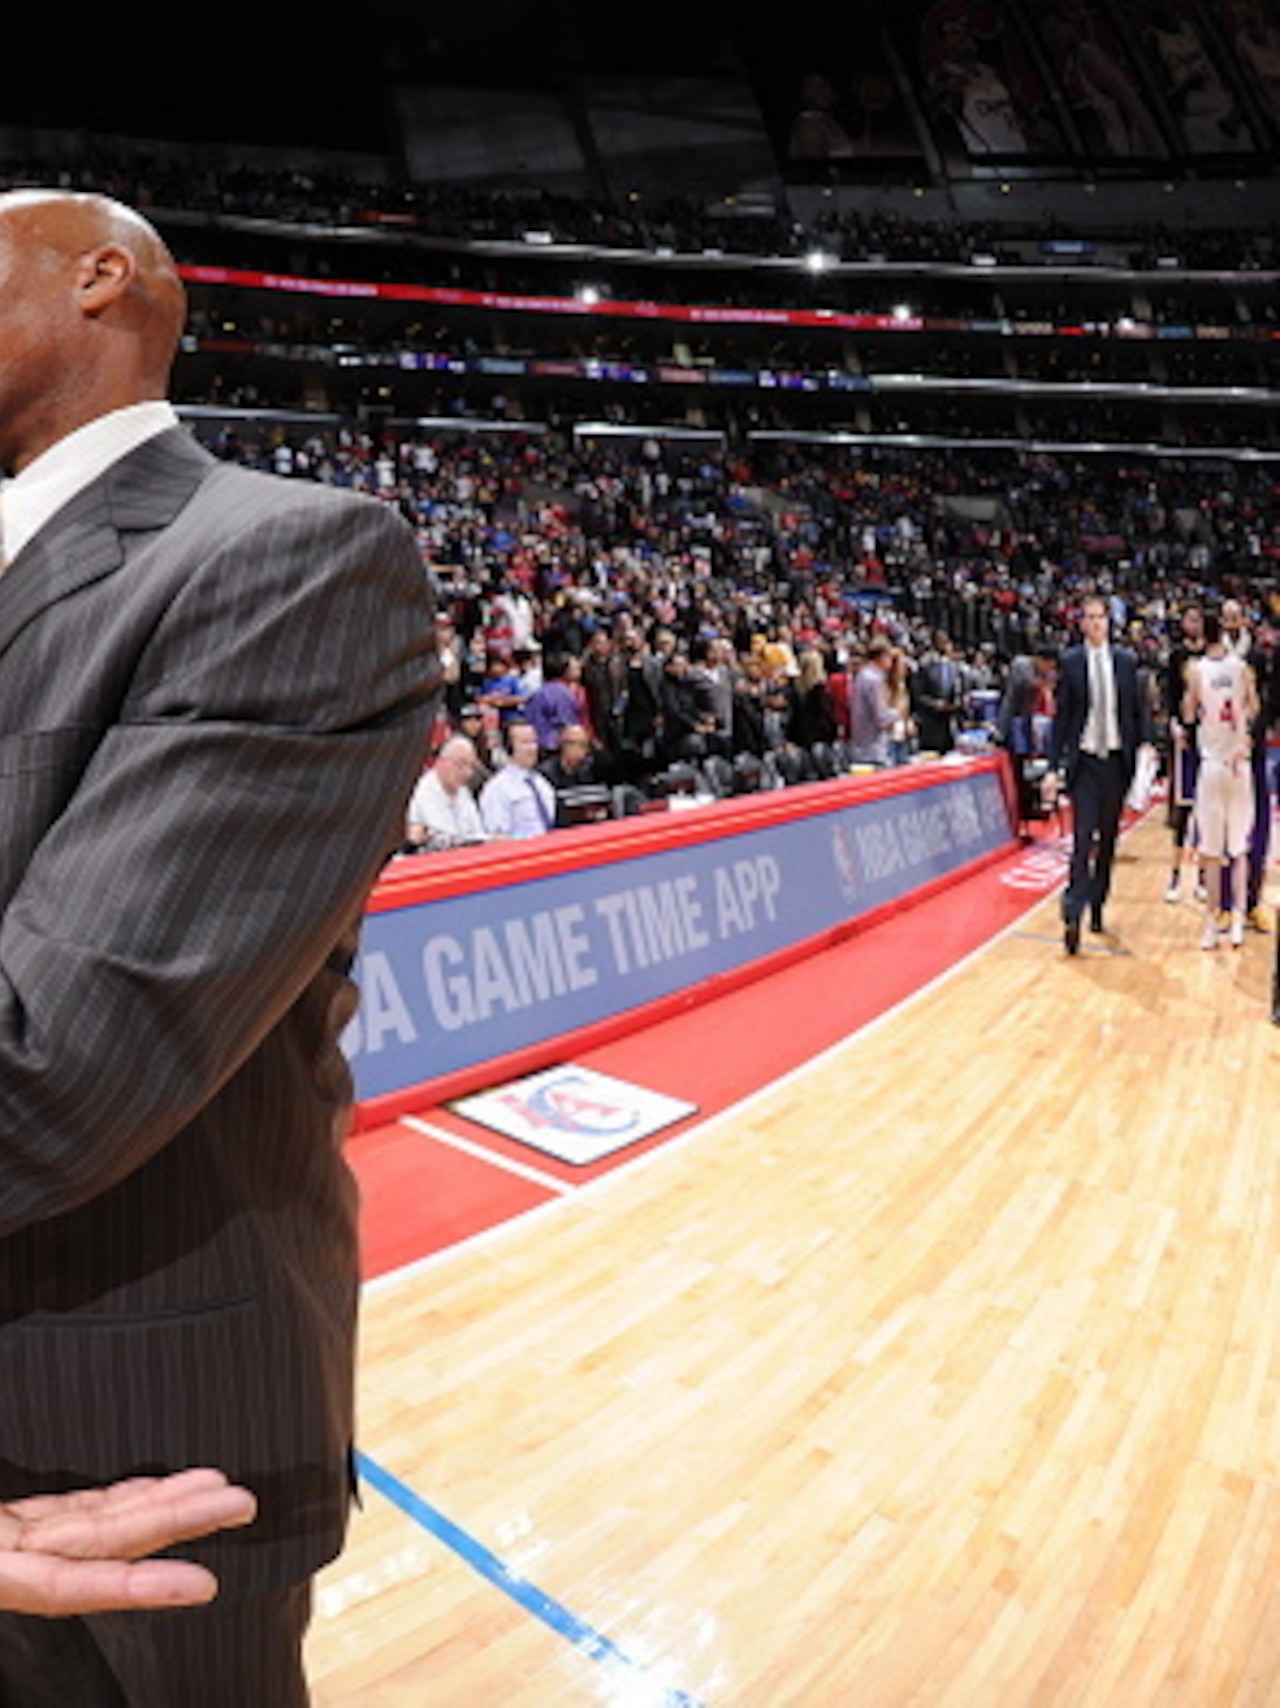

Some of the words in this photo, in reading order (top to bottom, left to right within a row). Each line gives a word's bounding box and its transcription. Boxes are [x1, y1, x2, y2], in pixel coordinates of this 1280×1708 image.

[422, 904, 598, 1031] GAME
[595, 874, 710, 974] TIME
[713, 854, 780, 940] APP
